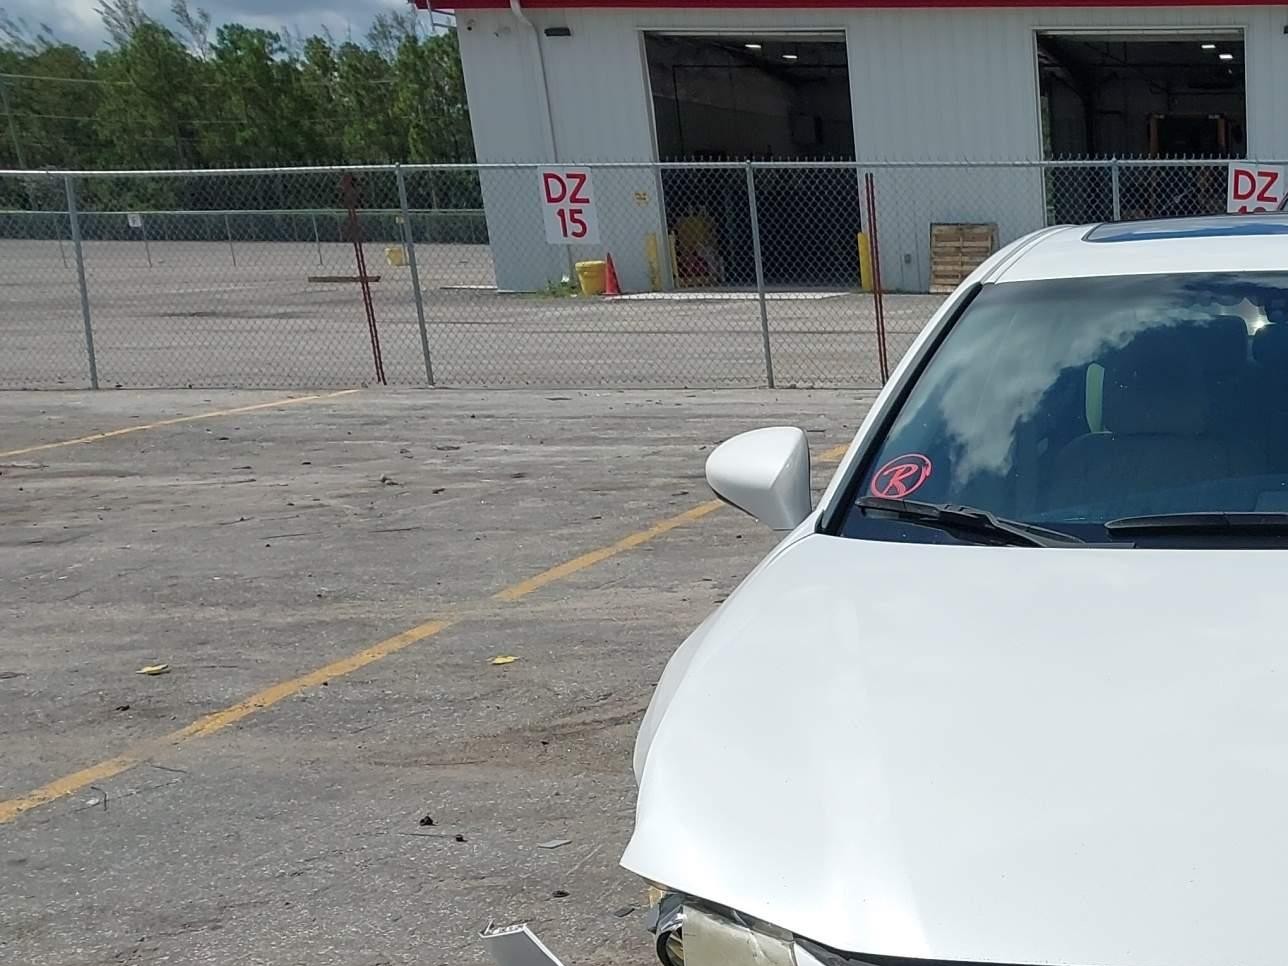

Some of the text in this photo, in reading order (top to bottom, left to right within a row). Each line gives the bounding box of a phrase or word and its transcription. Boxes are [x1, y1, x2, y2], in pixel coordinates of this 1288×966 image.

[543, 172, 590, 204] DZ
[1233, 169, 1279, 203] DZ
[557, 208, 587, 238] 15
